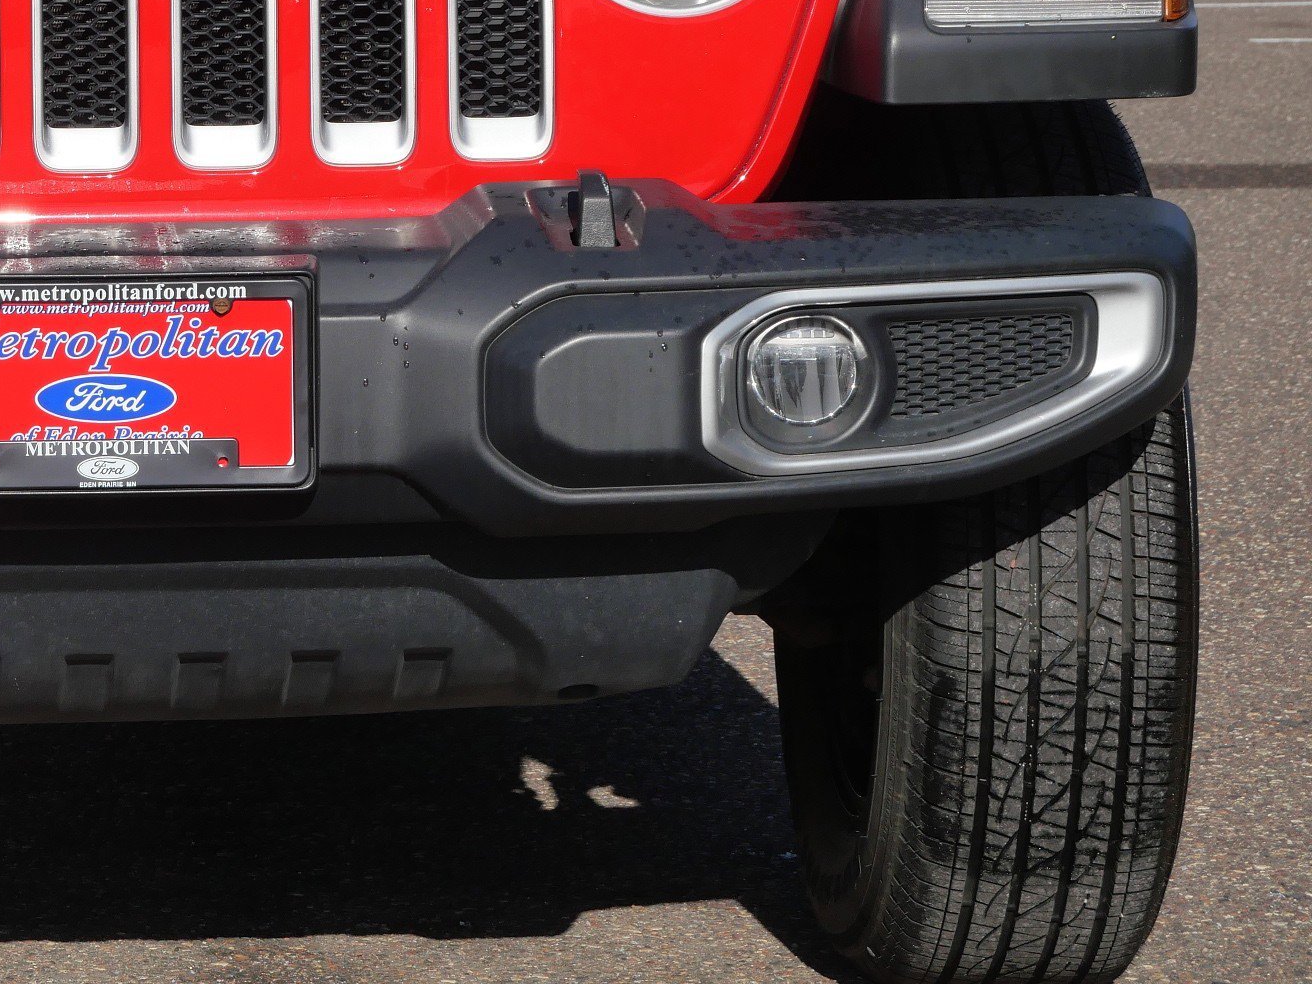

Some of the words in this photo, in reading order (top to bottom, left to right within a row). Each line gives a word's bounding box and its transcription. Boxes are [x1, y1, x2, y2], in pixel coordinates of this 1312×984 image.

[2, 301, 210, 317] www.metropolitanford.com
[65, 382, 147, 412] Ford
[26, 440, 190, 457] METROPOLITAN
[90, 460, 125, 476] Ford
